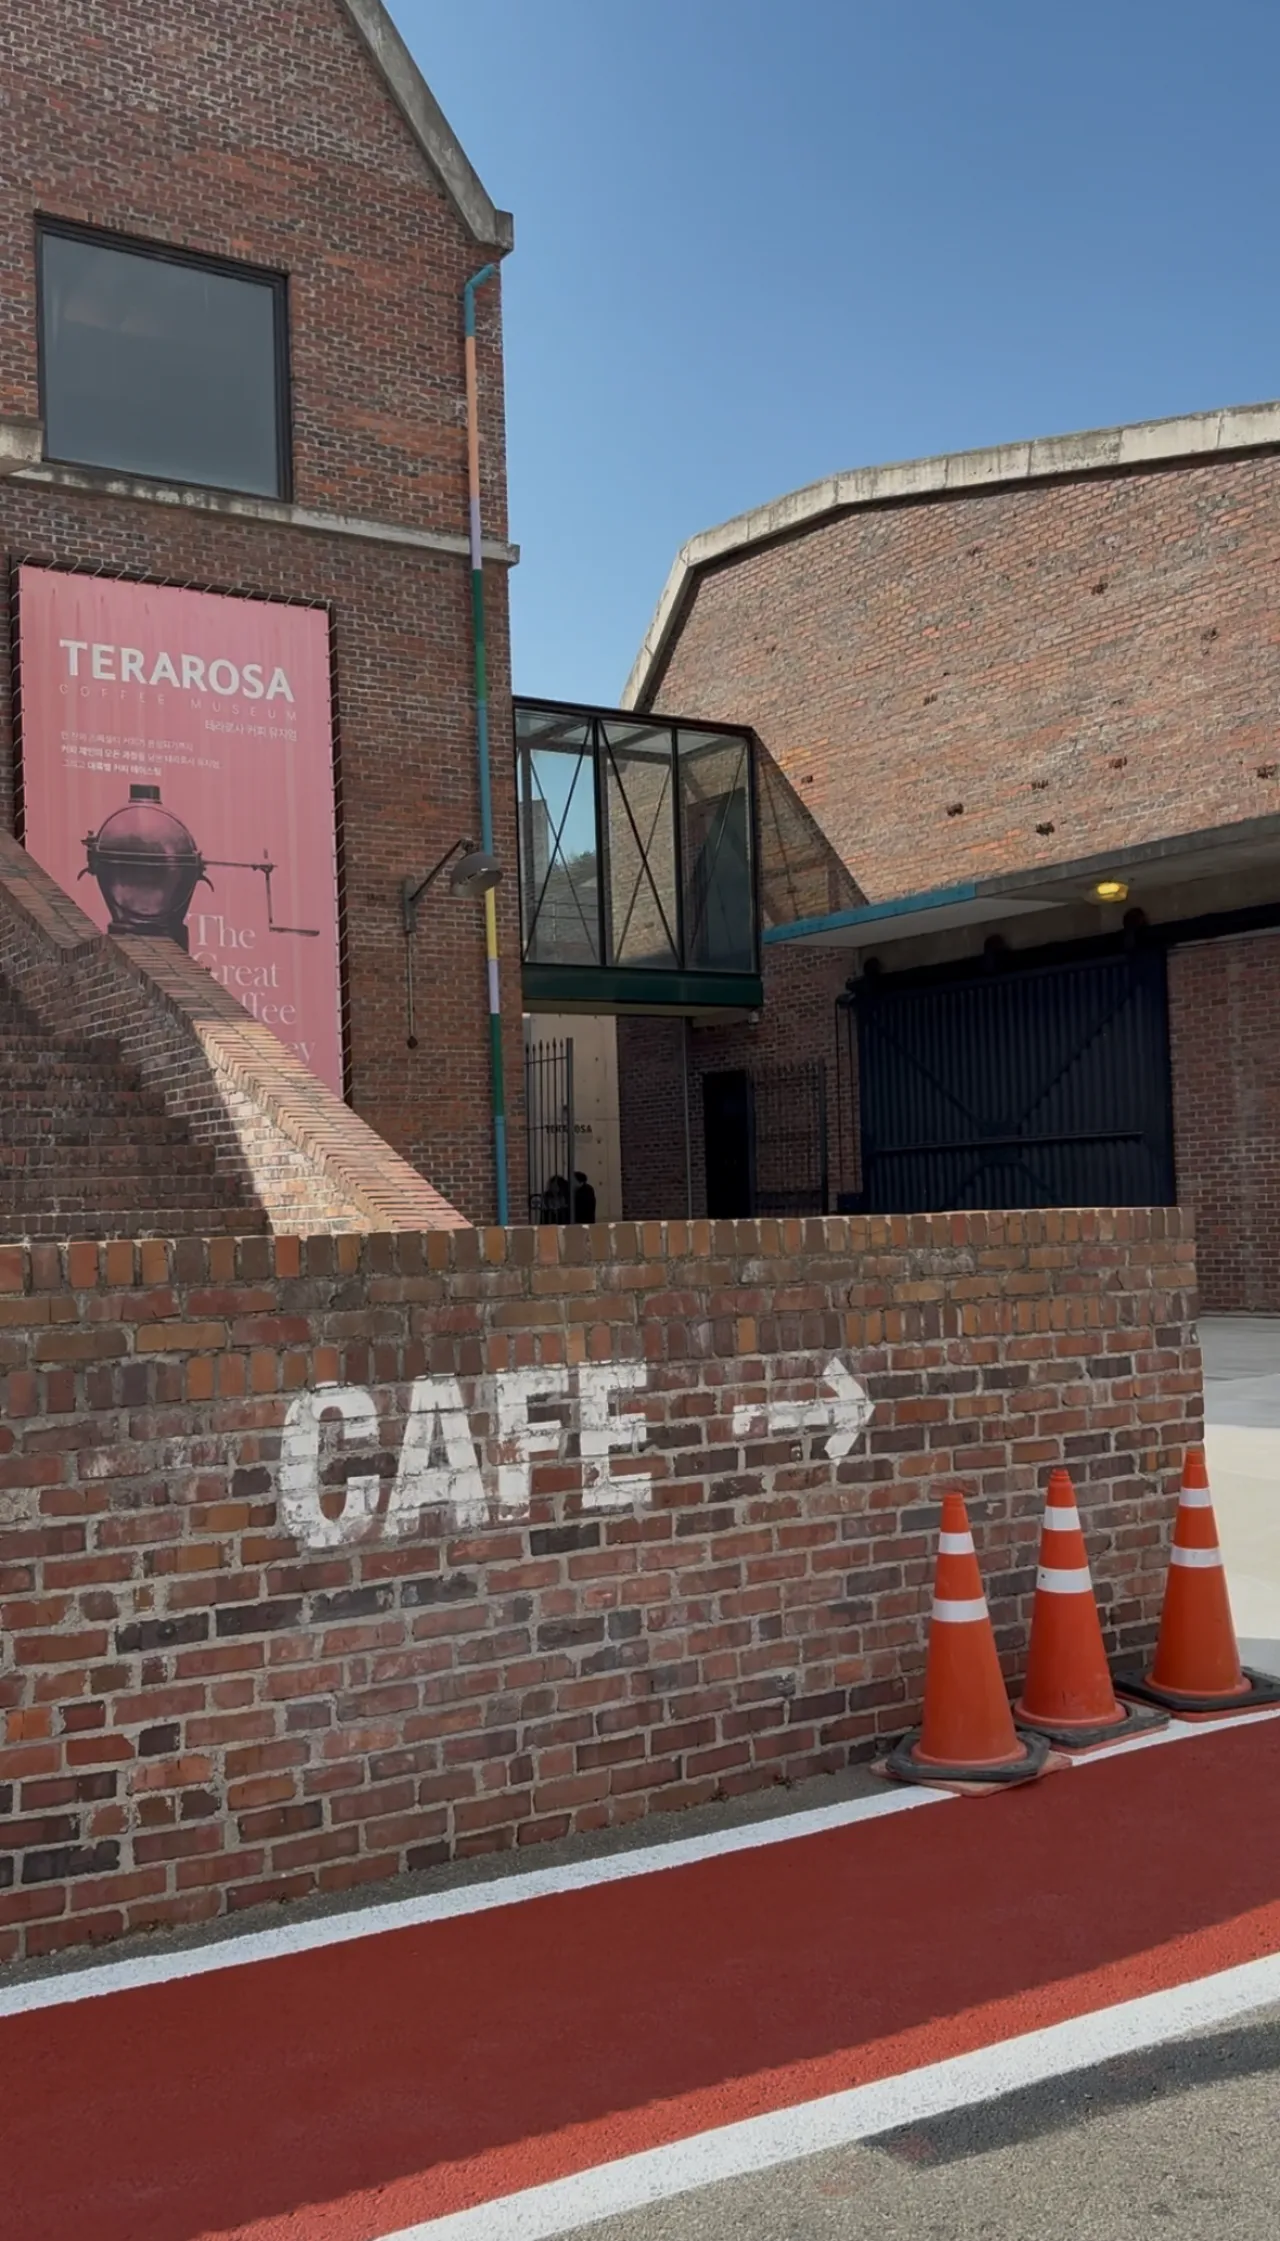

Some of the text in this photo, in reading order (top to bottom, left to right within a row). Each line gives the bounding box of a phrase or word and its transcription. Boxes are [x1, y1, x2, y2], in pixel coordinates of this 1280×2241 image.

[59, 639, 295, 703] TERAROSA
[59, 684, 297, 721] COFFEE MUSEUM
[205, 719, 245, 735] 테라로사
[246, 723, 268, 738] 커피
[187, 914, 256, 949] The
[279, 1360, 653, 1548] CAFE
